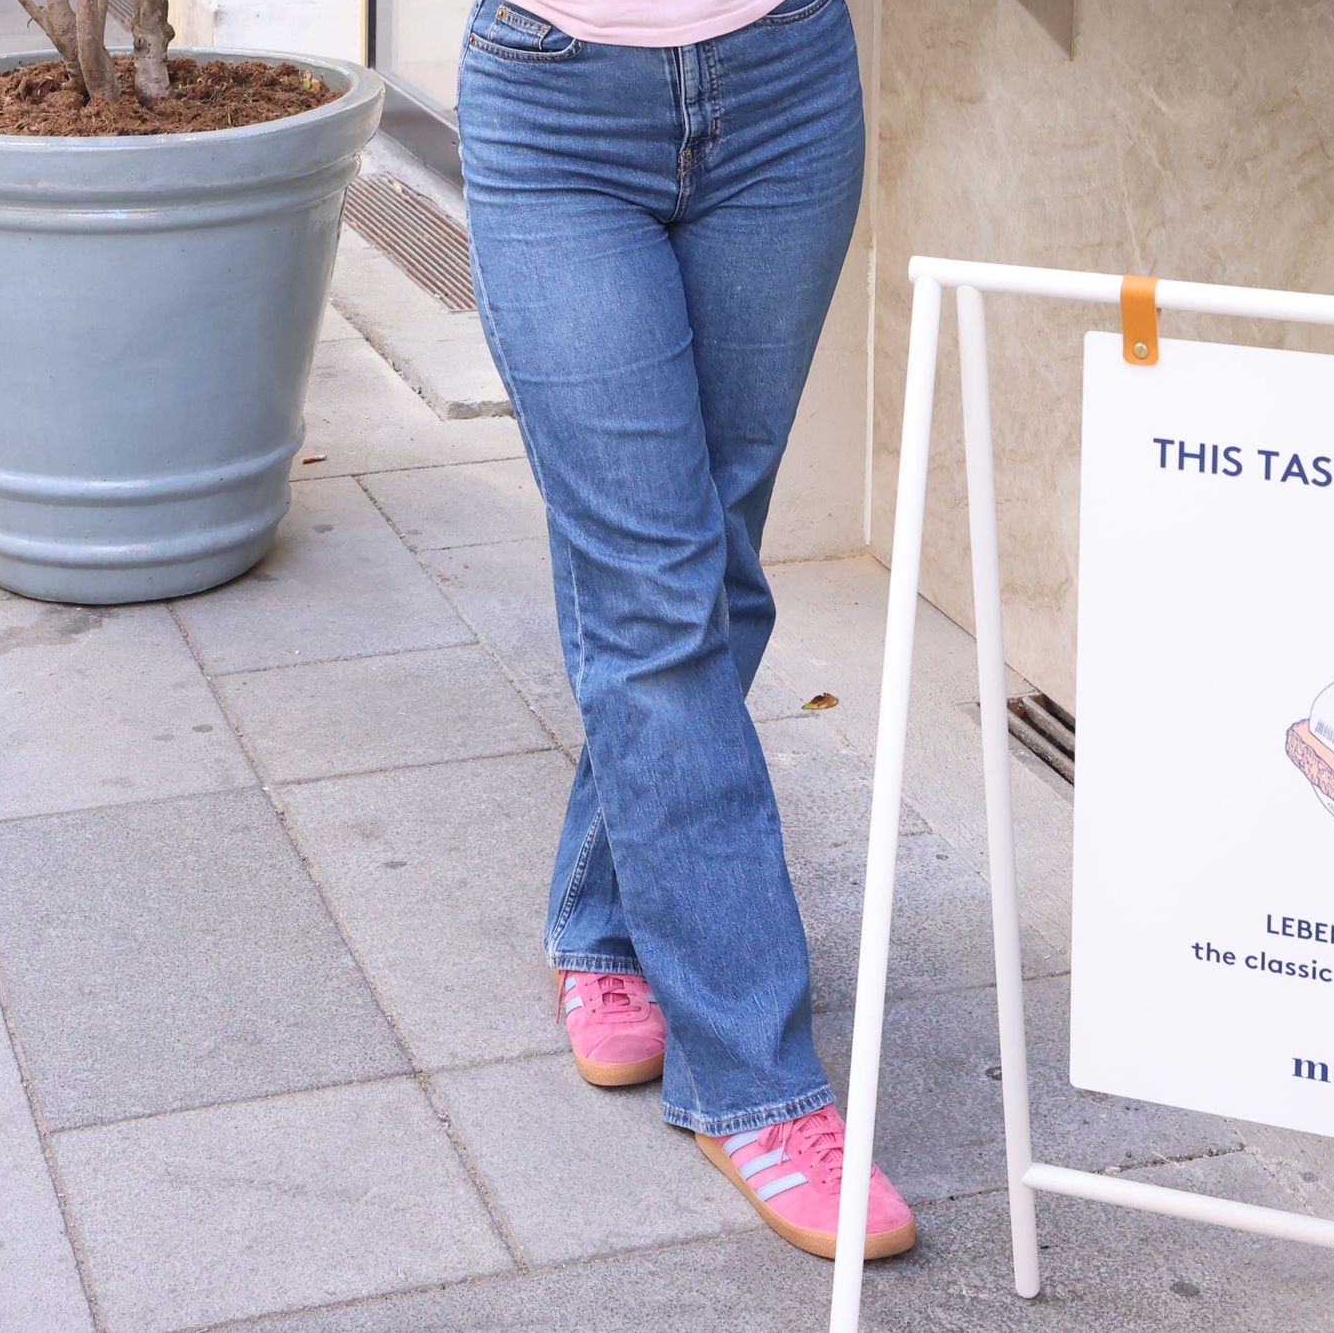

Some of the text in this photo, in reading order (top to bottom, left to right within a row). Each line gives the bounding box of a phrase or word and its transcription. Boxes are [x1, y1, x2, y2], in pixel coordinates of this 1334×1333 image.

[1153, 437, 1243, 477] THIS
[1191, 942, 1236, 966] the
[1244, 951, 1334, 983] classic
